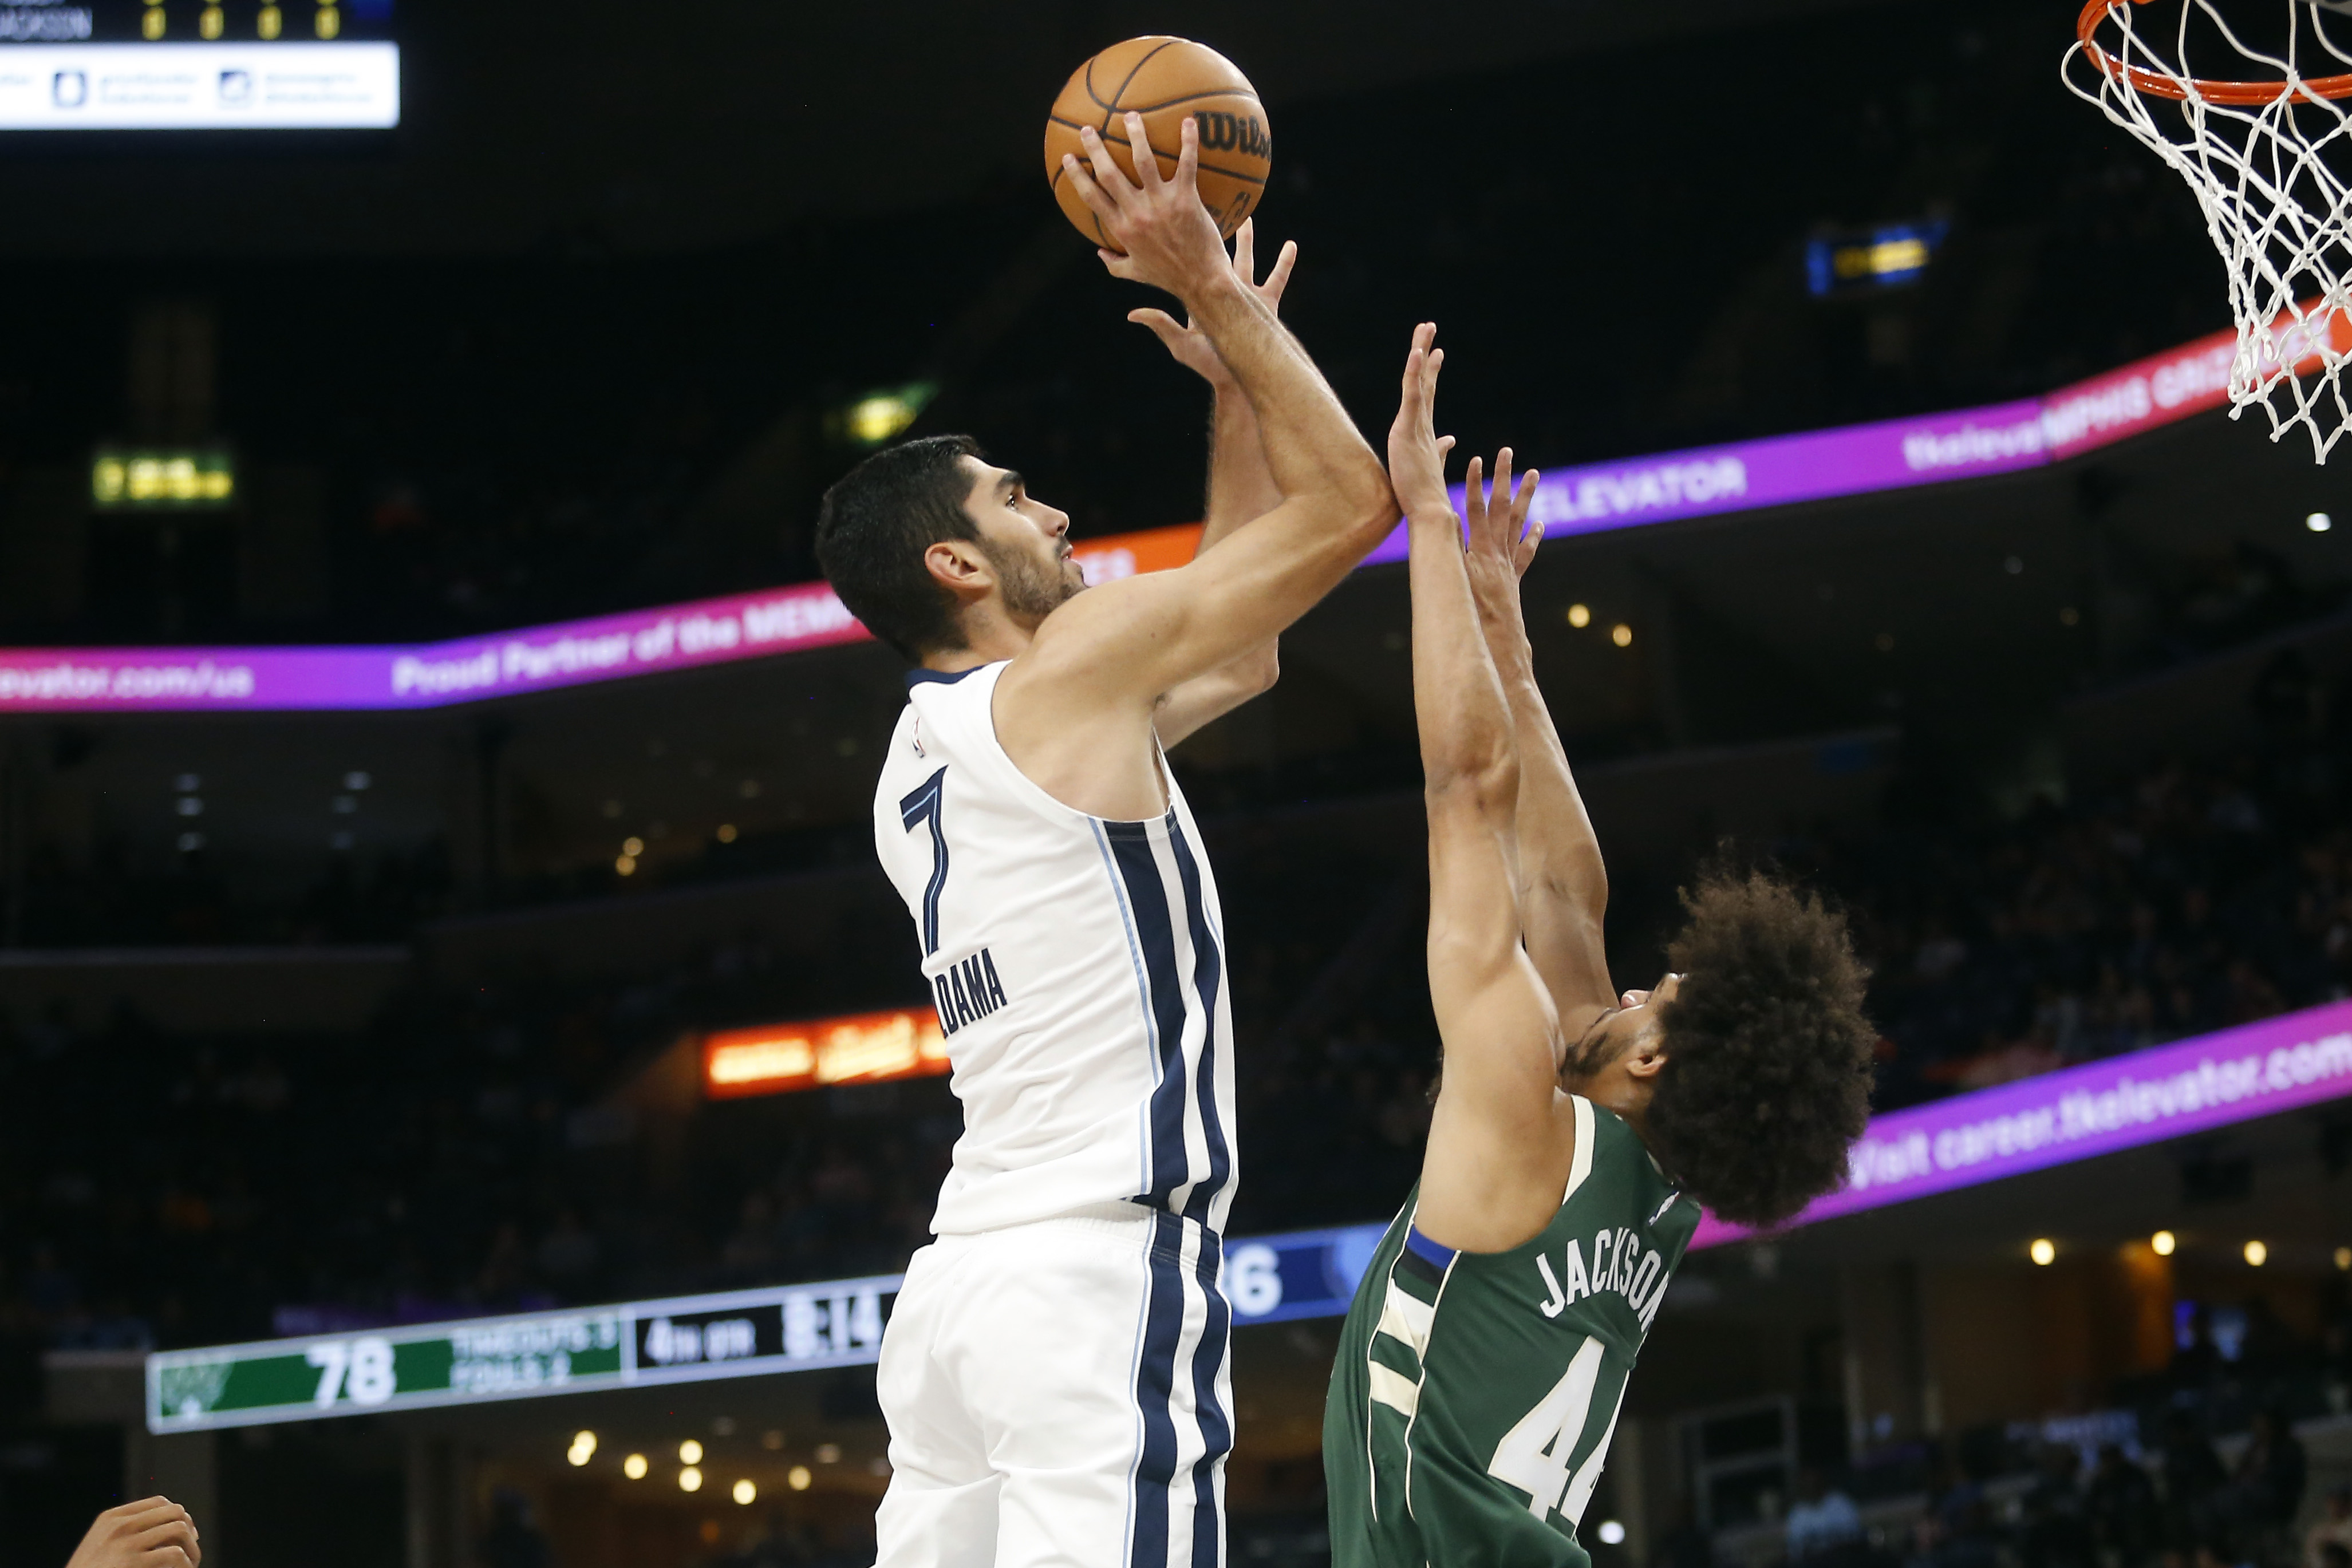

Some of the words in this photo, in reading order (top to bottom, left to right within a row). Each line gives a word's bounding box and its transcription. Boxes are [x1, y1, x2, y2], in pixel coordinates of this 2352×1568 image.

[392, 653, 499, 696] Proud
[502, 639, 630, 680] Partner
[632, 617, 676, 662] of
[678, 613, 741, 654] the
[899, 764, 949, 958] 7
[932, 947, 1008, 1040] DAMA
[305, 1335, 397, 1411] 78
